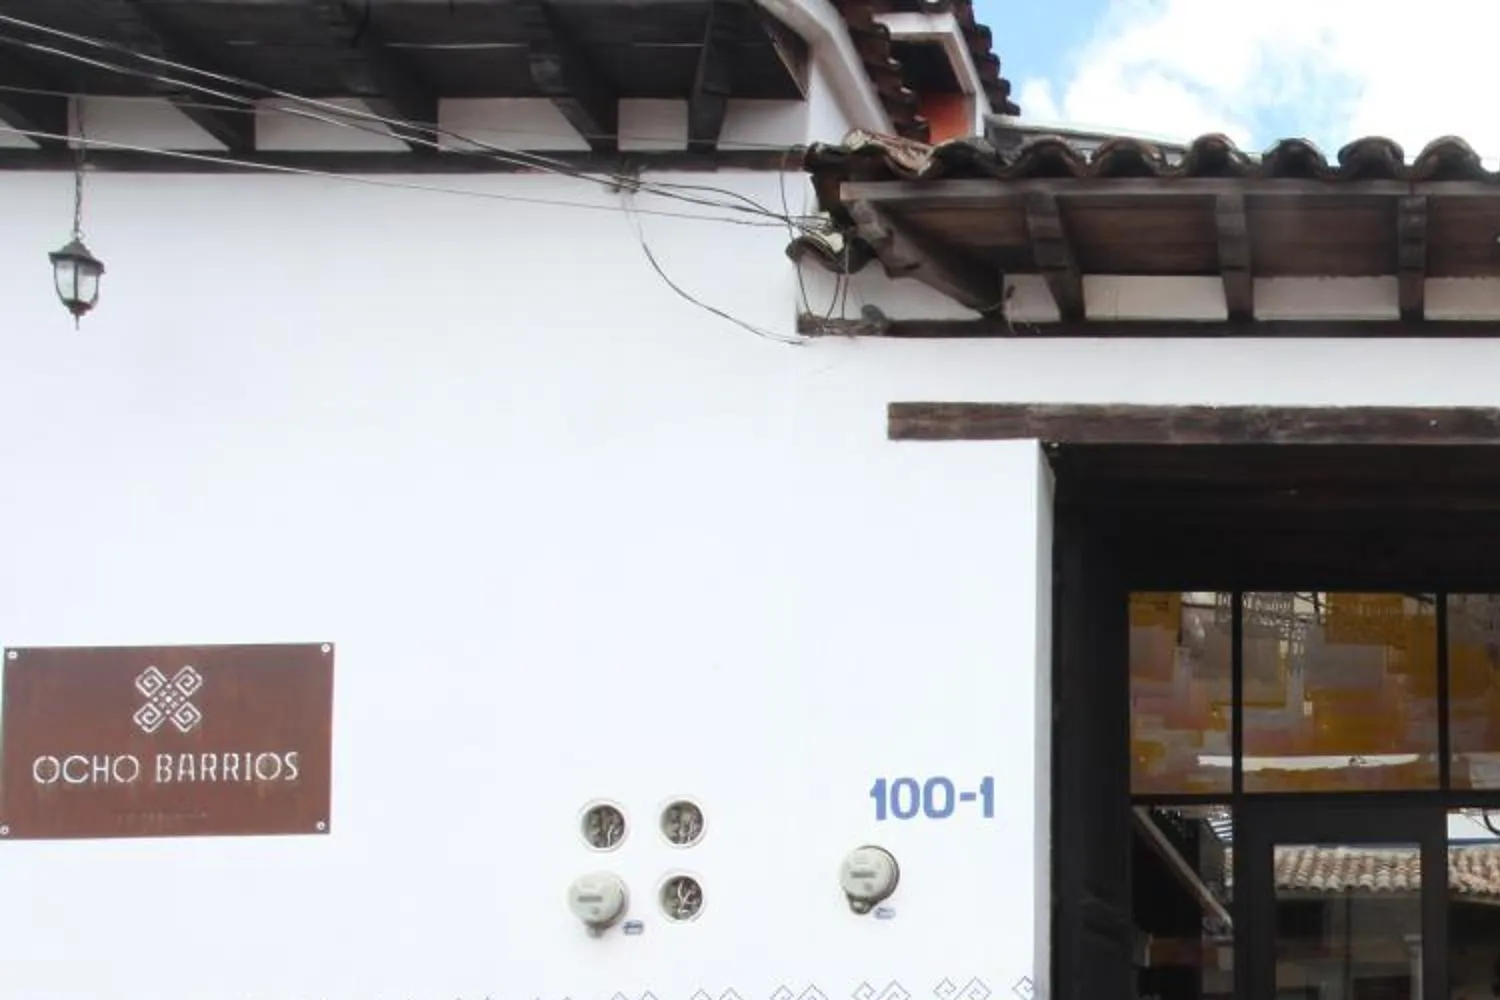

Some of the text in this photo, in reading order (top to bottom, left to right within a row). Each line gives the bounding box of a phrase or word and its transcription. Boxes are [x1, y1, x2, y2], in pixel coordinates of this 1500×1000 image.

[32, 751, 300, 785] OCHO BARRIOS
[869, 776, 995, 820] 100-1
